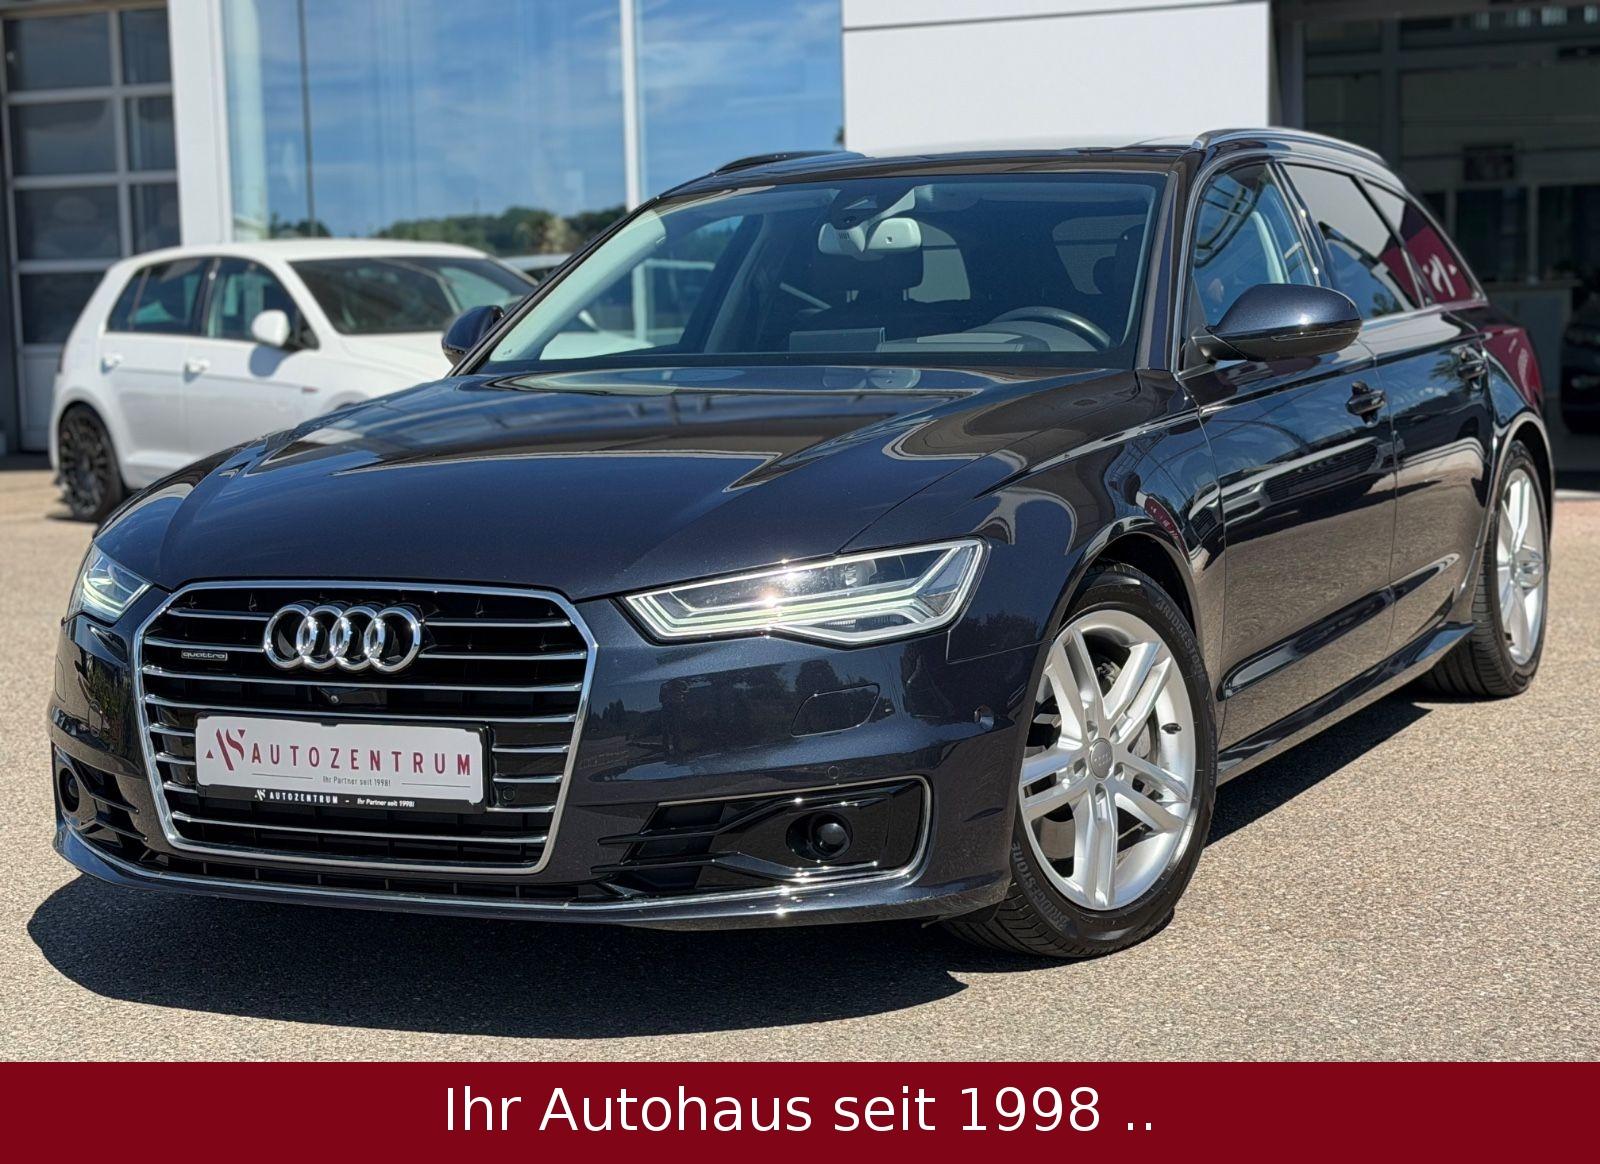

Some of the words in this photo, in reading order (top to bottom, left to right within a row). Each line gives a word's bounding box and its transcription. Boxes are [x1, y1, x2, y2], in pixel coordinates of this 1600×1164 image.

[182, 651, 226, 660] quattro
[251, 742, 471, 776] AUTOZENTRUM
[322, 775, 332, 784] Ihr
[334, 776, 358, 785] Partner
[359, 778, 372, 787] seit
[374, 778, 391, 787] 1998!
[269, 791, 338, 804] AUTOZENTRUM
[357, 797, 365, 805] Ihr
[366, 798, 387, 807] Partner
[398, 800, 415, 808] 1998!
